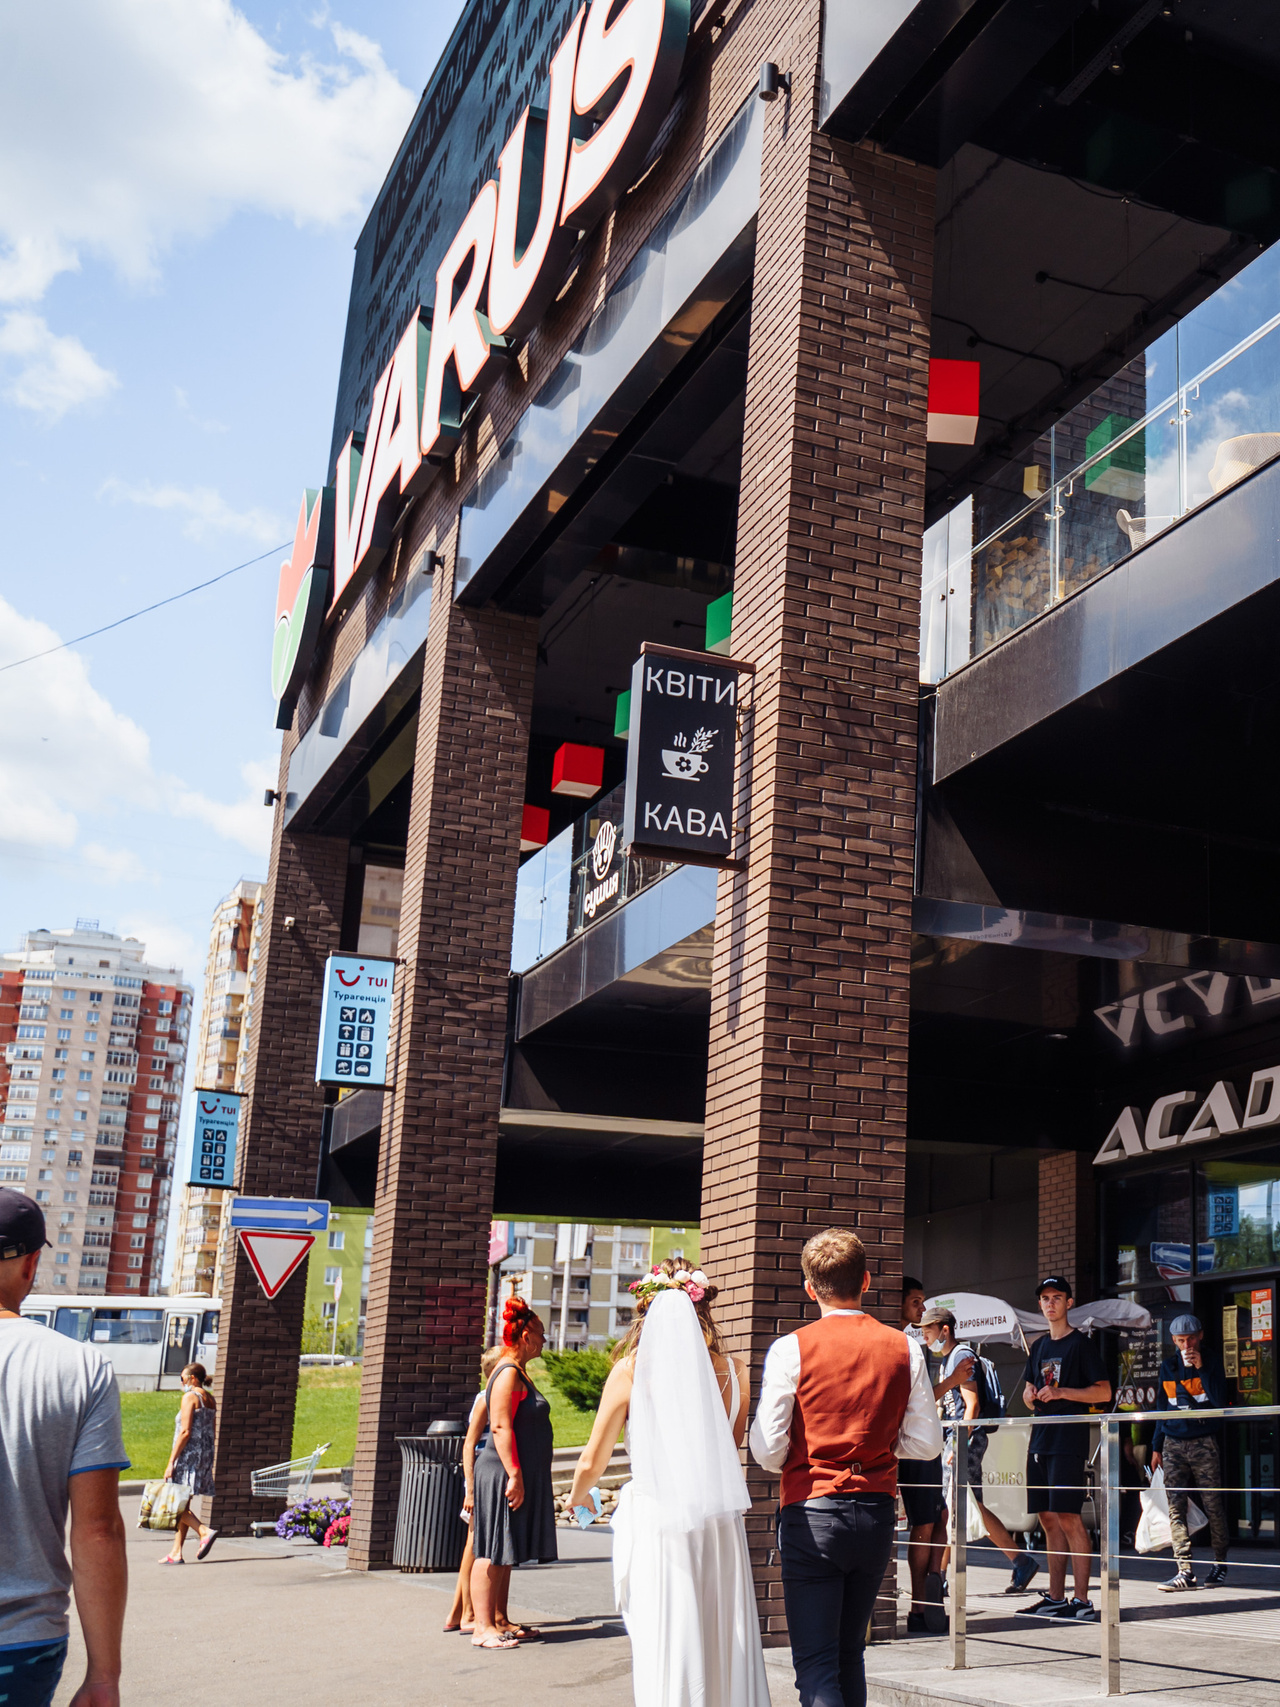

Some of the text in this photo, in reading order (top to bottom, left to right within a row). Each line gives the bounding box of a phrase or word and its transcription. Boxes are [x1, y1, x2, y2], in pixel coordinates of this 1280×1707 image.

[474, 58, 515, 163] ПАРК
[327, 0, 672, 622] VARUS
[646, 666, 735, 706] КВІТИ
[644, 802, 728, 840] КАВА
[367, 976, 387, 988] TUI
[334, 990, 386, 1003] Турагенція
[221, 1106, 236, 1115] TUI
[960, 1315, 1007, 1330] ВИРОБНИЦТВА
